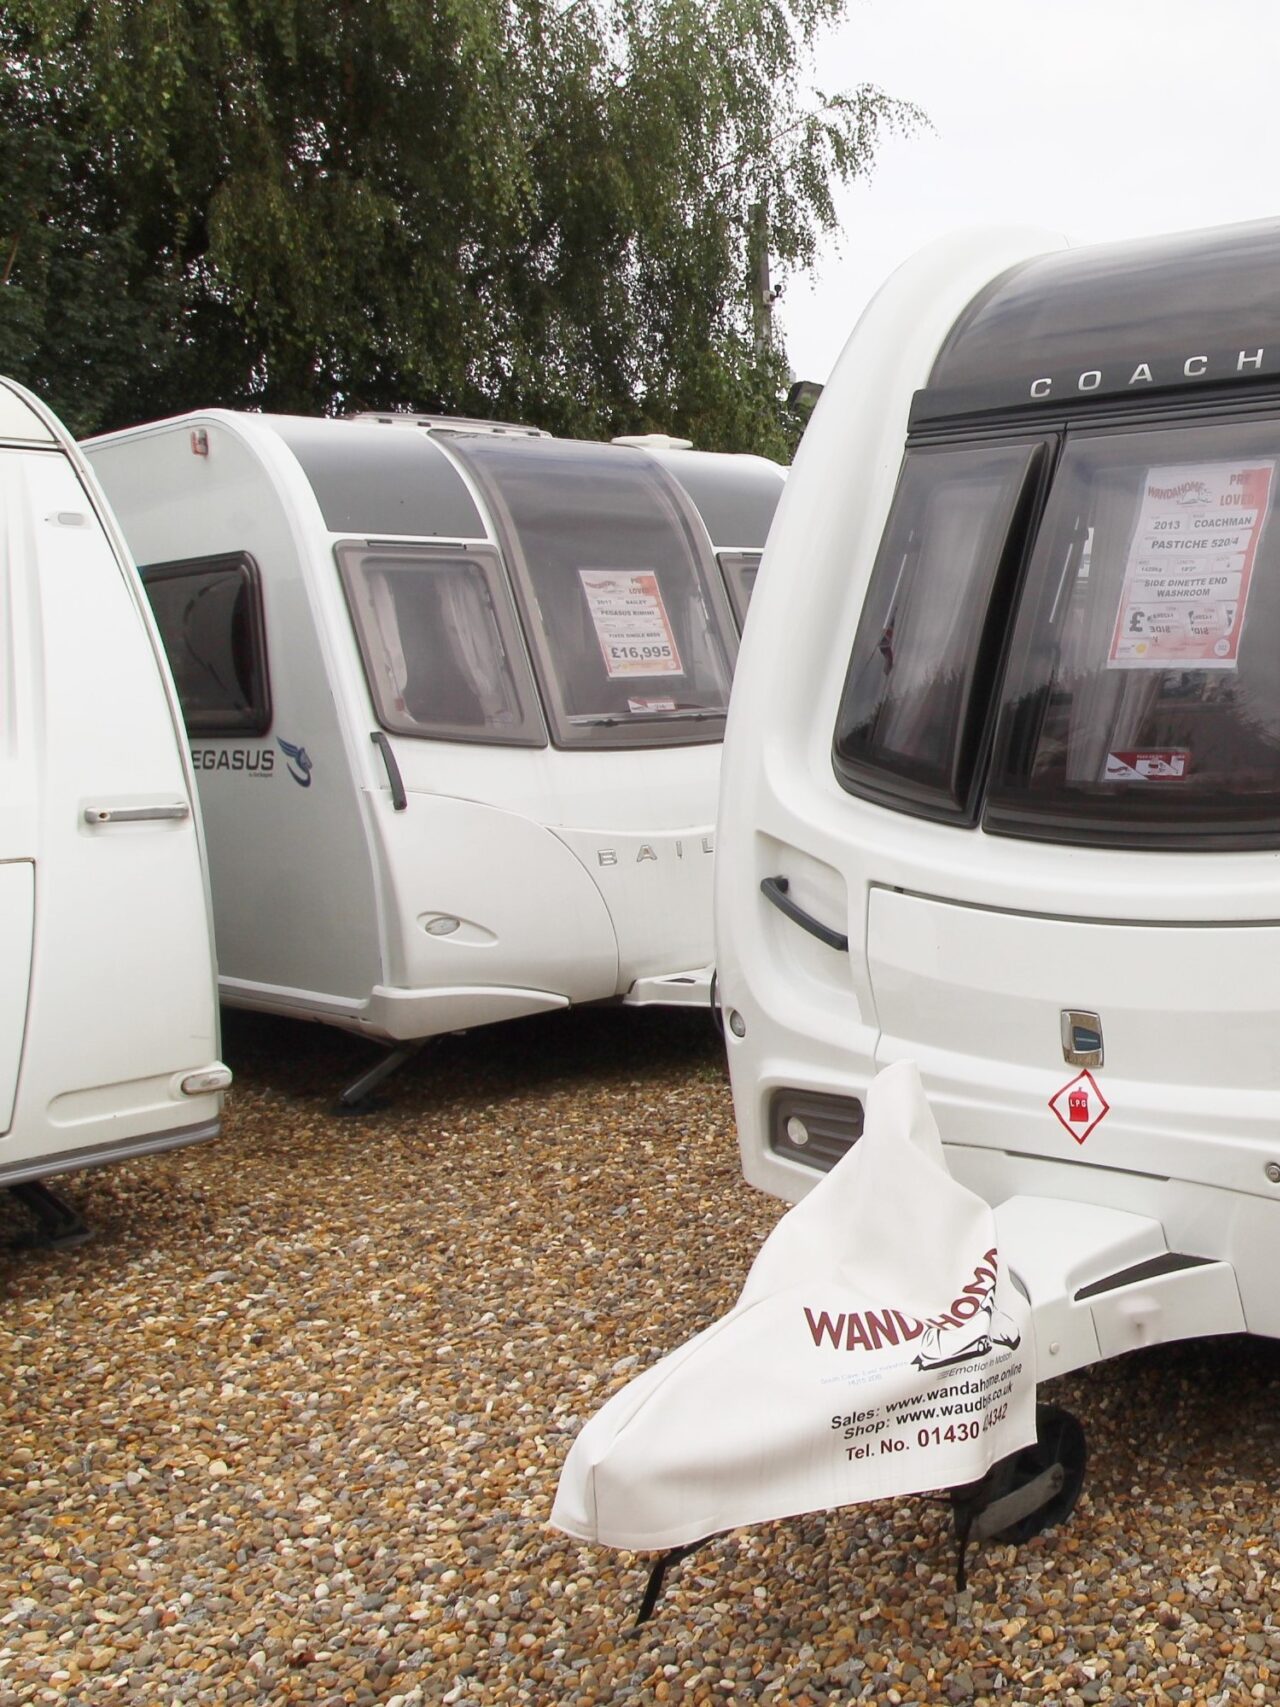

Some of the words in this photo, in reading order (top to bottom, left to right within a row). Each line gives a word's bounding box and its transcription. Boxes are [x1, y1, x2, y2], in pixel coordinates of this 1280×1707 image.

[1153, 521, 1181, 530] 2013
[1194, 517, 1253, 529] COACHMAN
[1151, 539, 1209, 549] PASTICHE
[1144, 579, 1166, 587] SIDE
[1168, 578, 1206, 587] DINETTE
[1208, 576, 1228, 585] END
[1156, 588, 1211, 598] WASHROOM
[611, 645, 671, 661] £16,995
[192, 749, 275, 771] EGASUS
[598, 838, 714, 867] BAIL
[1070, 1099, 1087, 1108] LPG
[831, 1407, 880, 1430] Sales:
[844, 1418, 890, 1440] Shop:
[846, 1445, 875, 1461] Tel.
[881, 1438, 910, 1455] No.
[917, 1421, 980, 1448] 01430
